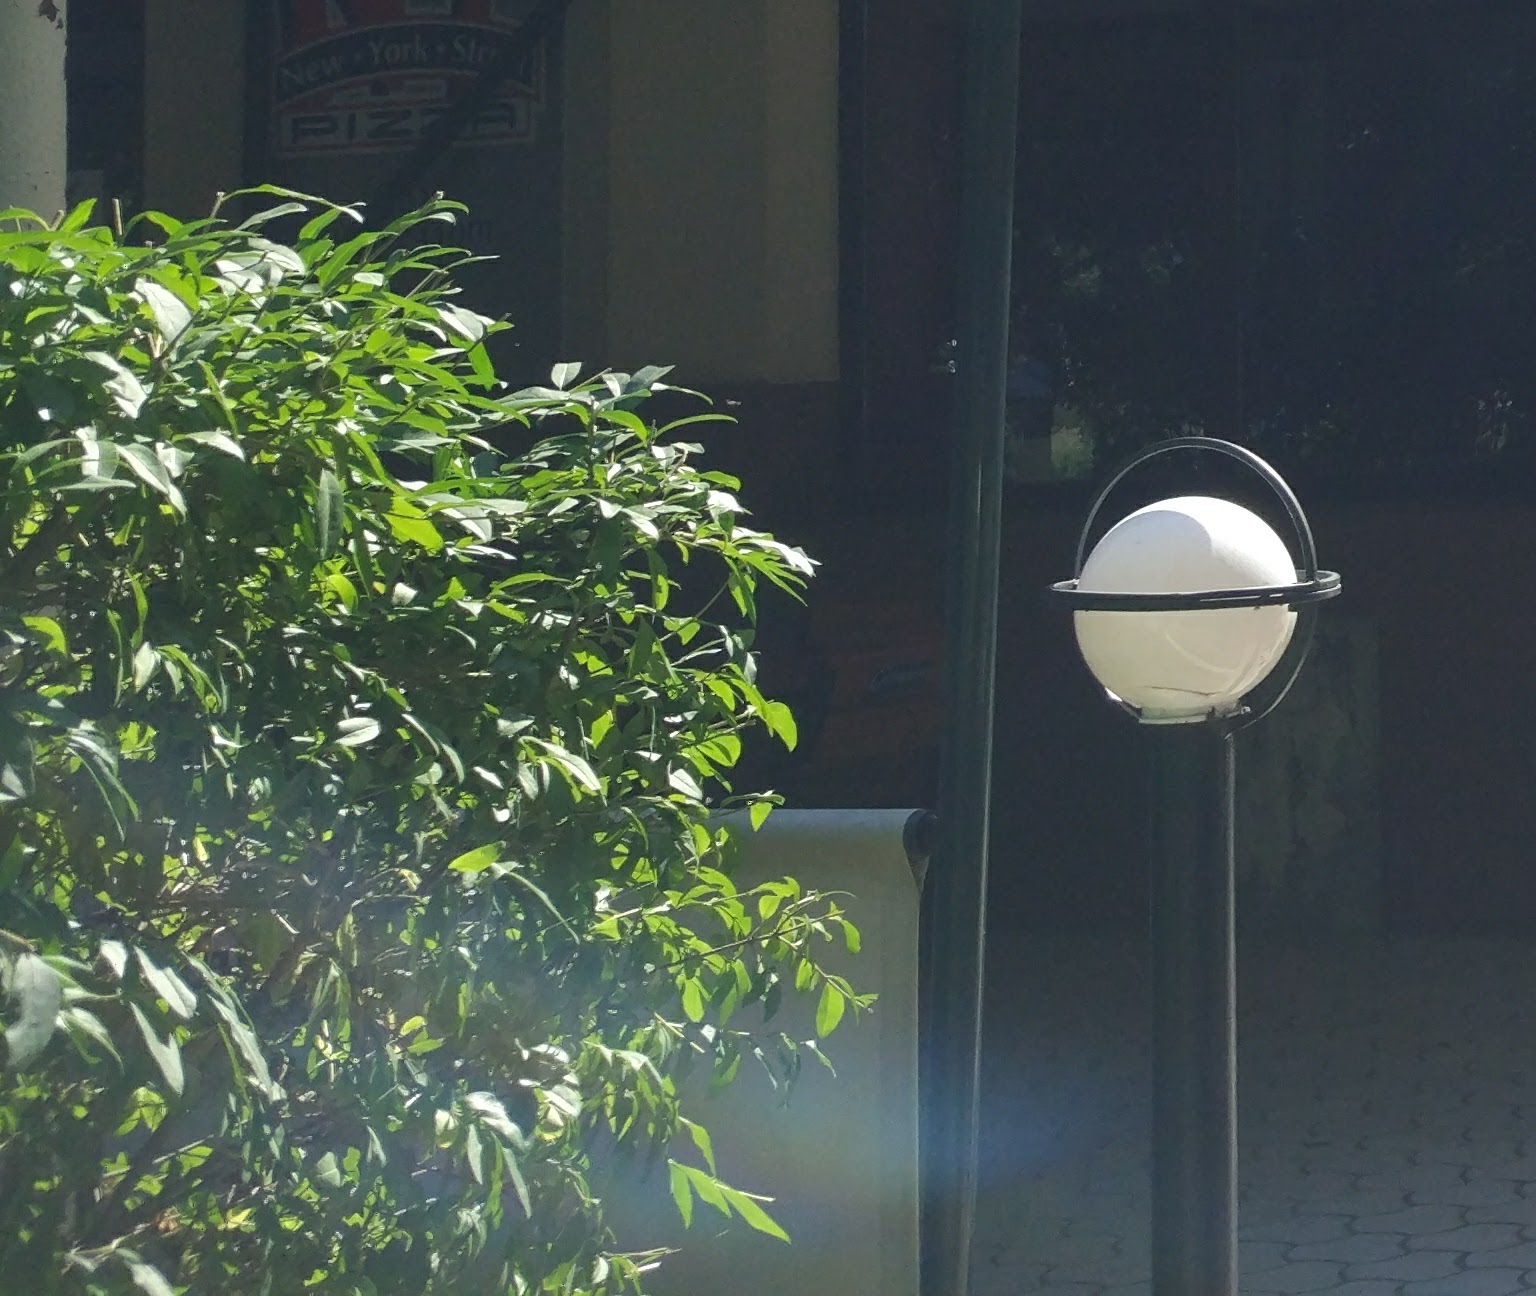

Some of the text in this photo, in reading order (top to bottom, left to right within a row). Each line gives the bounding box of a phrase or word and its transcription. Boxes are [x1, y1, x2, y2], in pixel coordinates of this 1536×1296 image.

[279, 33, 526, 85] New York Strt
